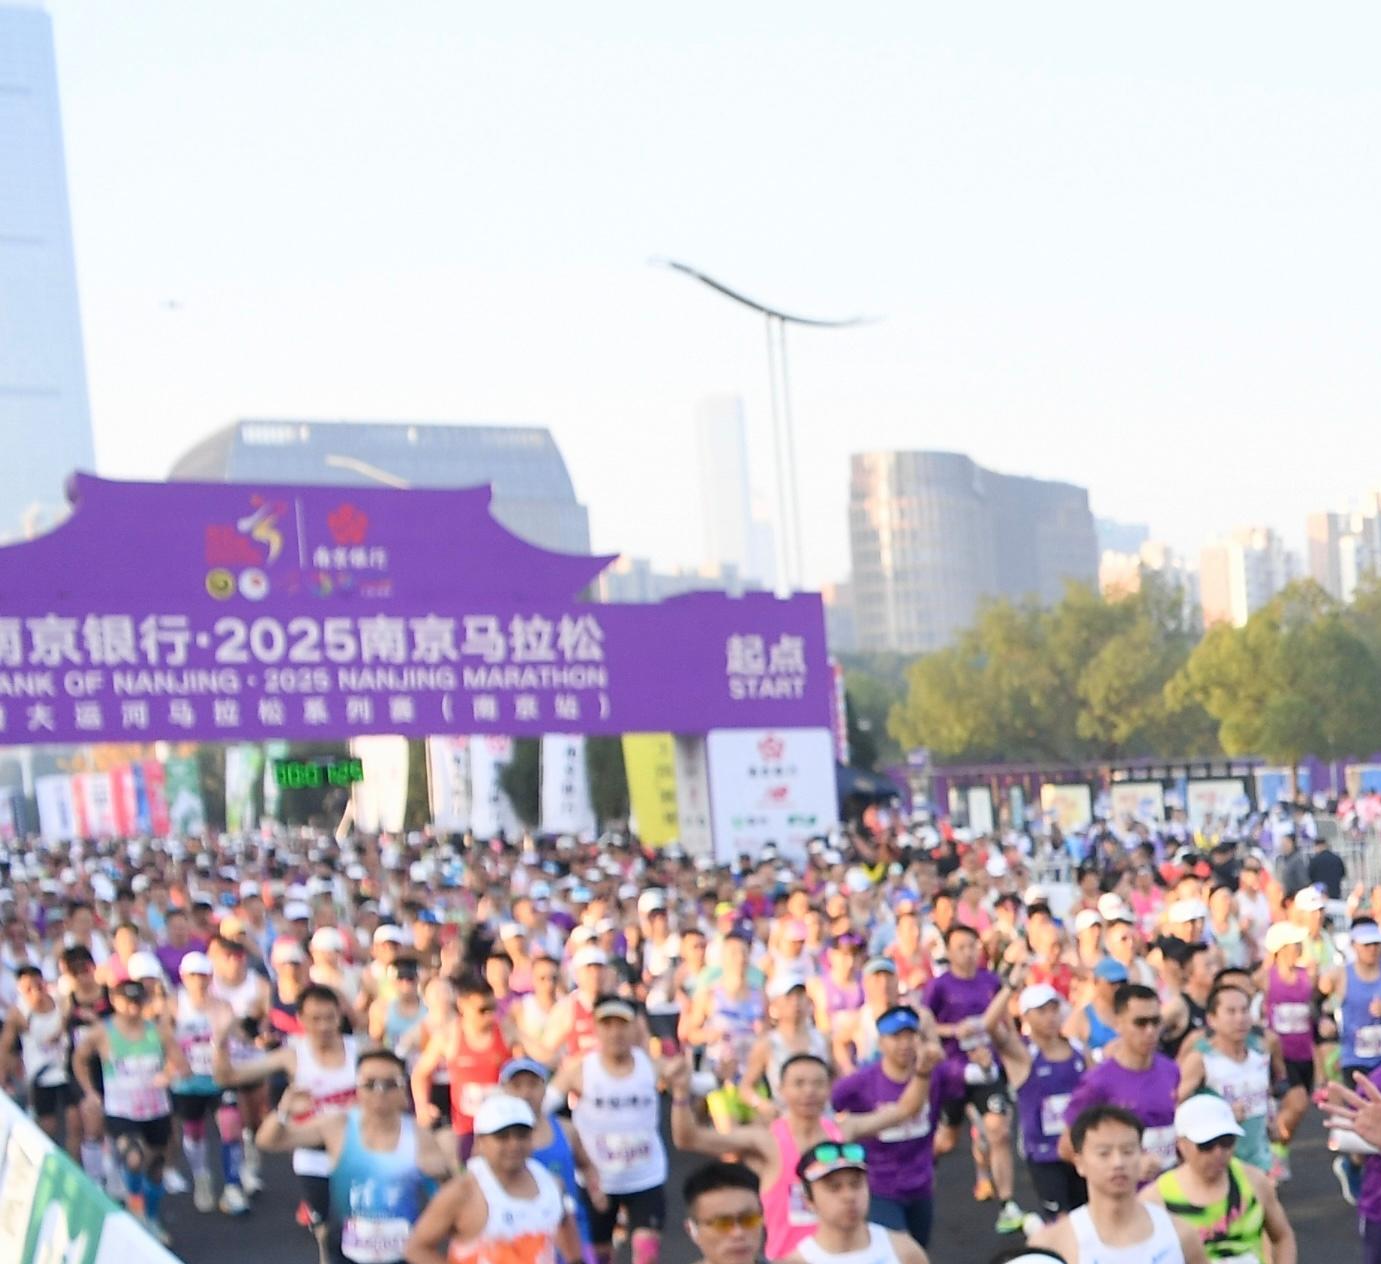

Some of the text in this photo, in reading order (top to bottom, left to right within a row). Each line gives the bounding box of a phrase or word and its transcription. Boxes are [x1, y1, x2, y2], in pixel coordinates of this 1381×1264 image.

[726, 633, 806, 677] 起点
[63, 670, 102, 695] OF
[112, 669, 241, 695] NANJING
[338, 666, 454, 691] NANJING
[463, 664, 607, 689] MARATHON
[728, 676, 806, 700] START
